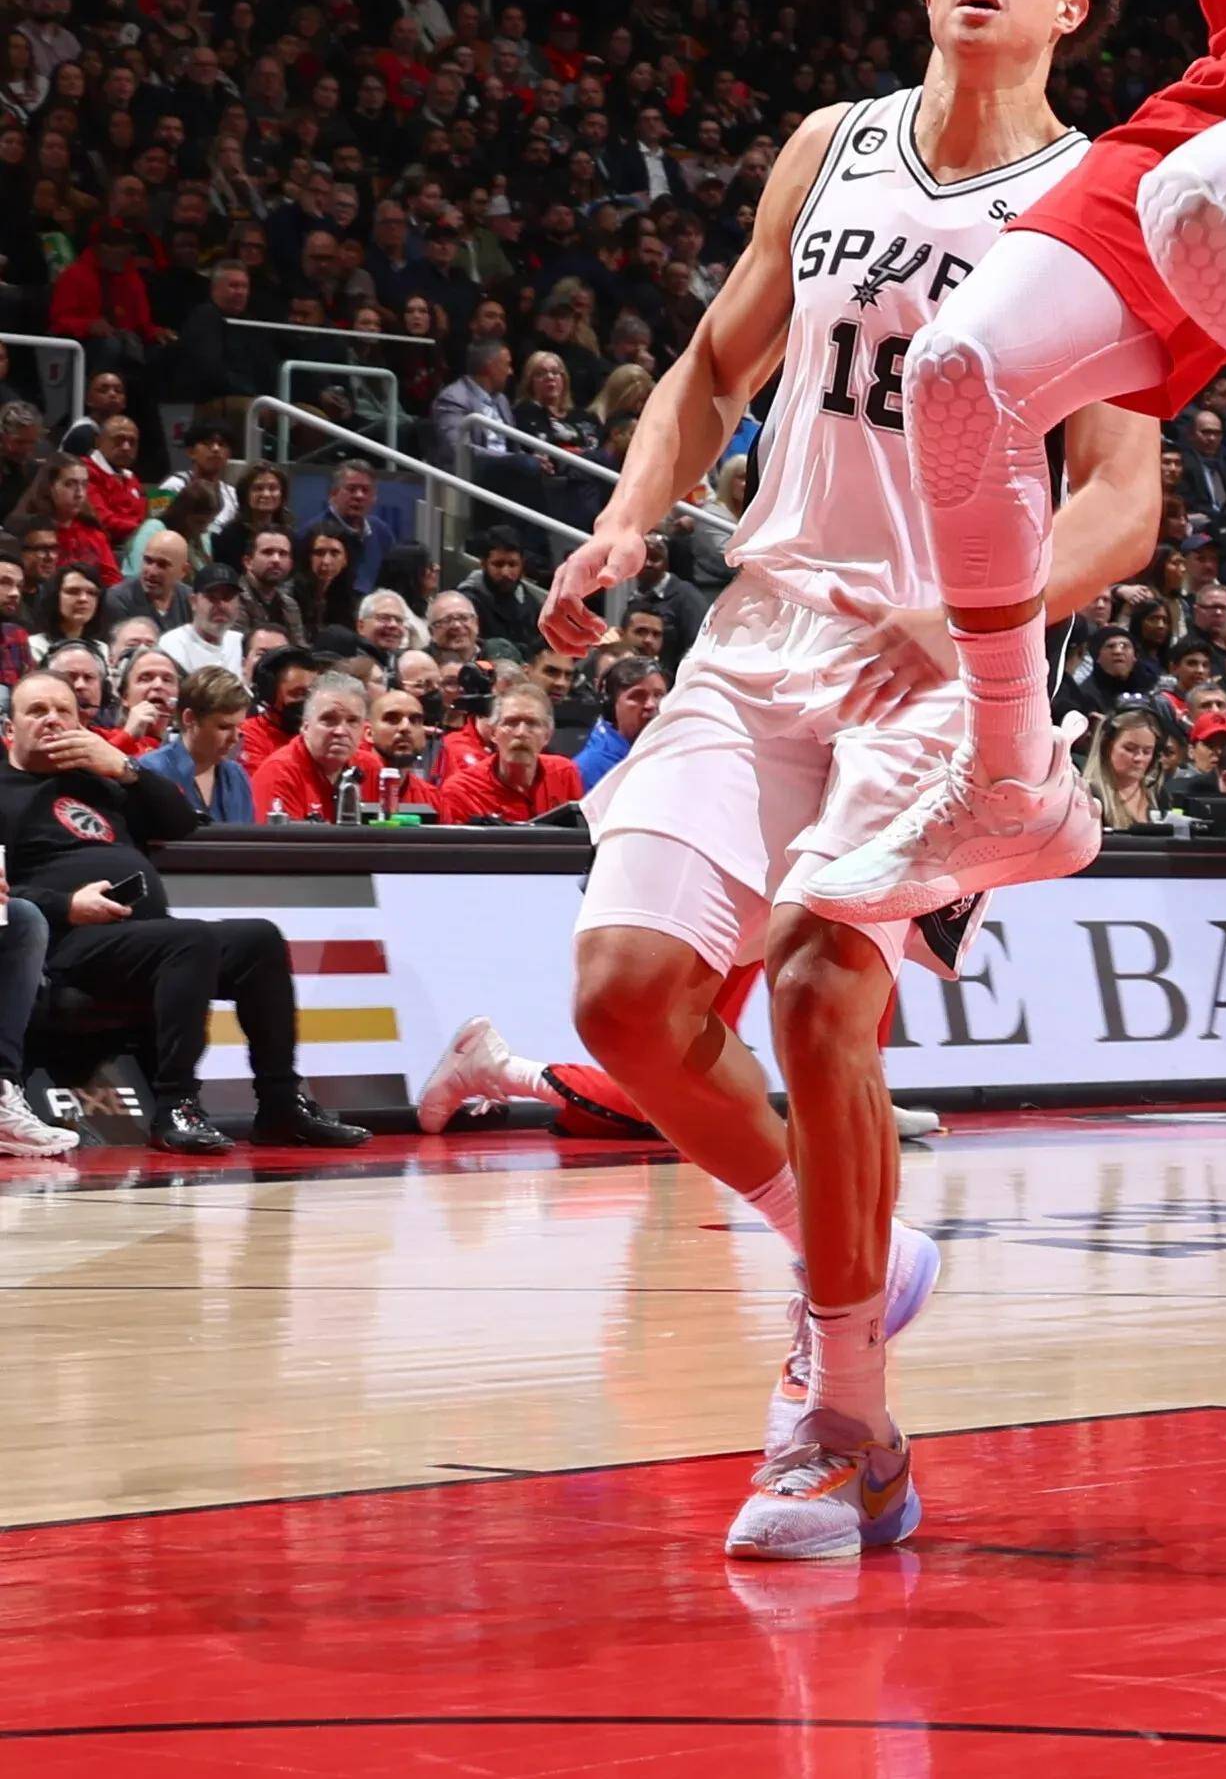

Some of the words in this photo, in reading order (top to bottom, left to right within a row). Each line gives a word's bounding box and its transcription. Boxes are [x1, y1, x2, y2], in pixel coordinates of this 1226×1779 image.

[853, 126, 888, 155] 6
[798, 228, 975, 309] SPUR
[819, 318, 914, 434] 18
[46, 1086, 144, 1117] AXE
